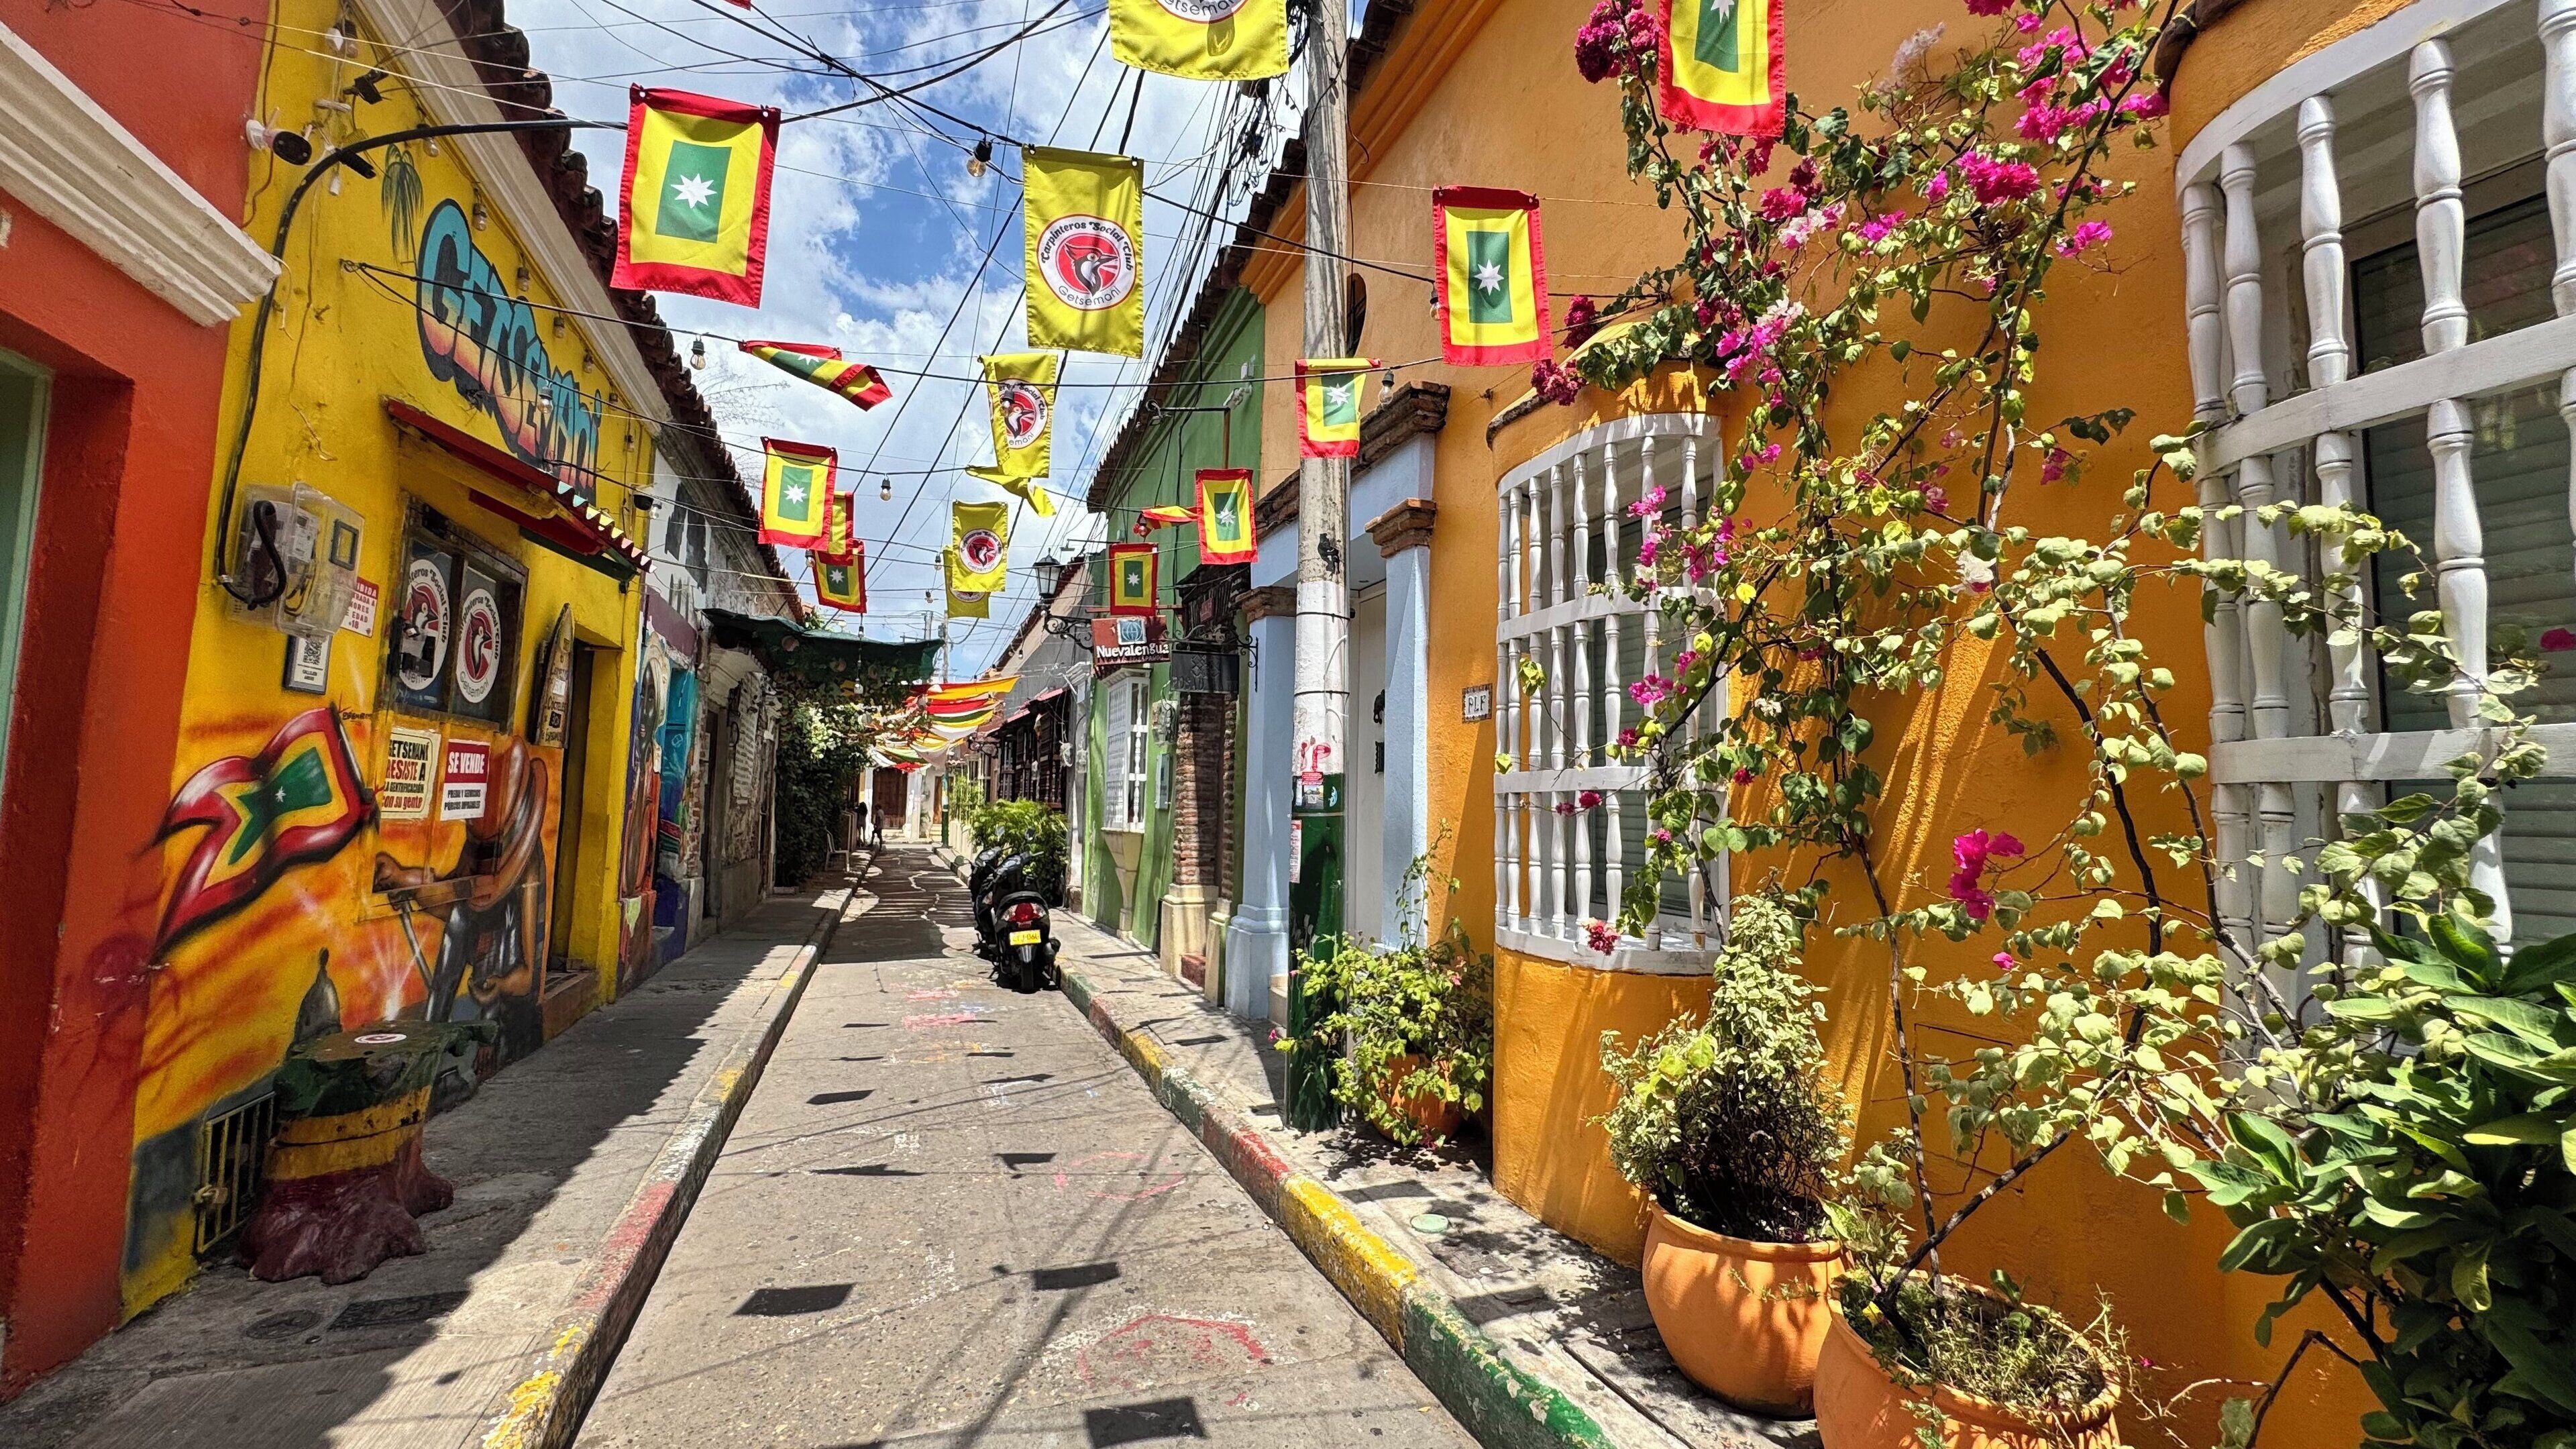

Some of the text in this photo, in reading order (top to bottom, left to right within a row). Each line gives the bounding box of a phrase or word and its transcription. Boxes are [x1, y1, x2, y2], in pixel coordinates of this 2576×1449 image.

[1040, 221, 1134, 271] Carpinteros Social Club
[419, 762, 426, 781] A
[448, 751, 485, 773] SE VENDE
[403, 796, 423, 810] gente
